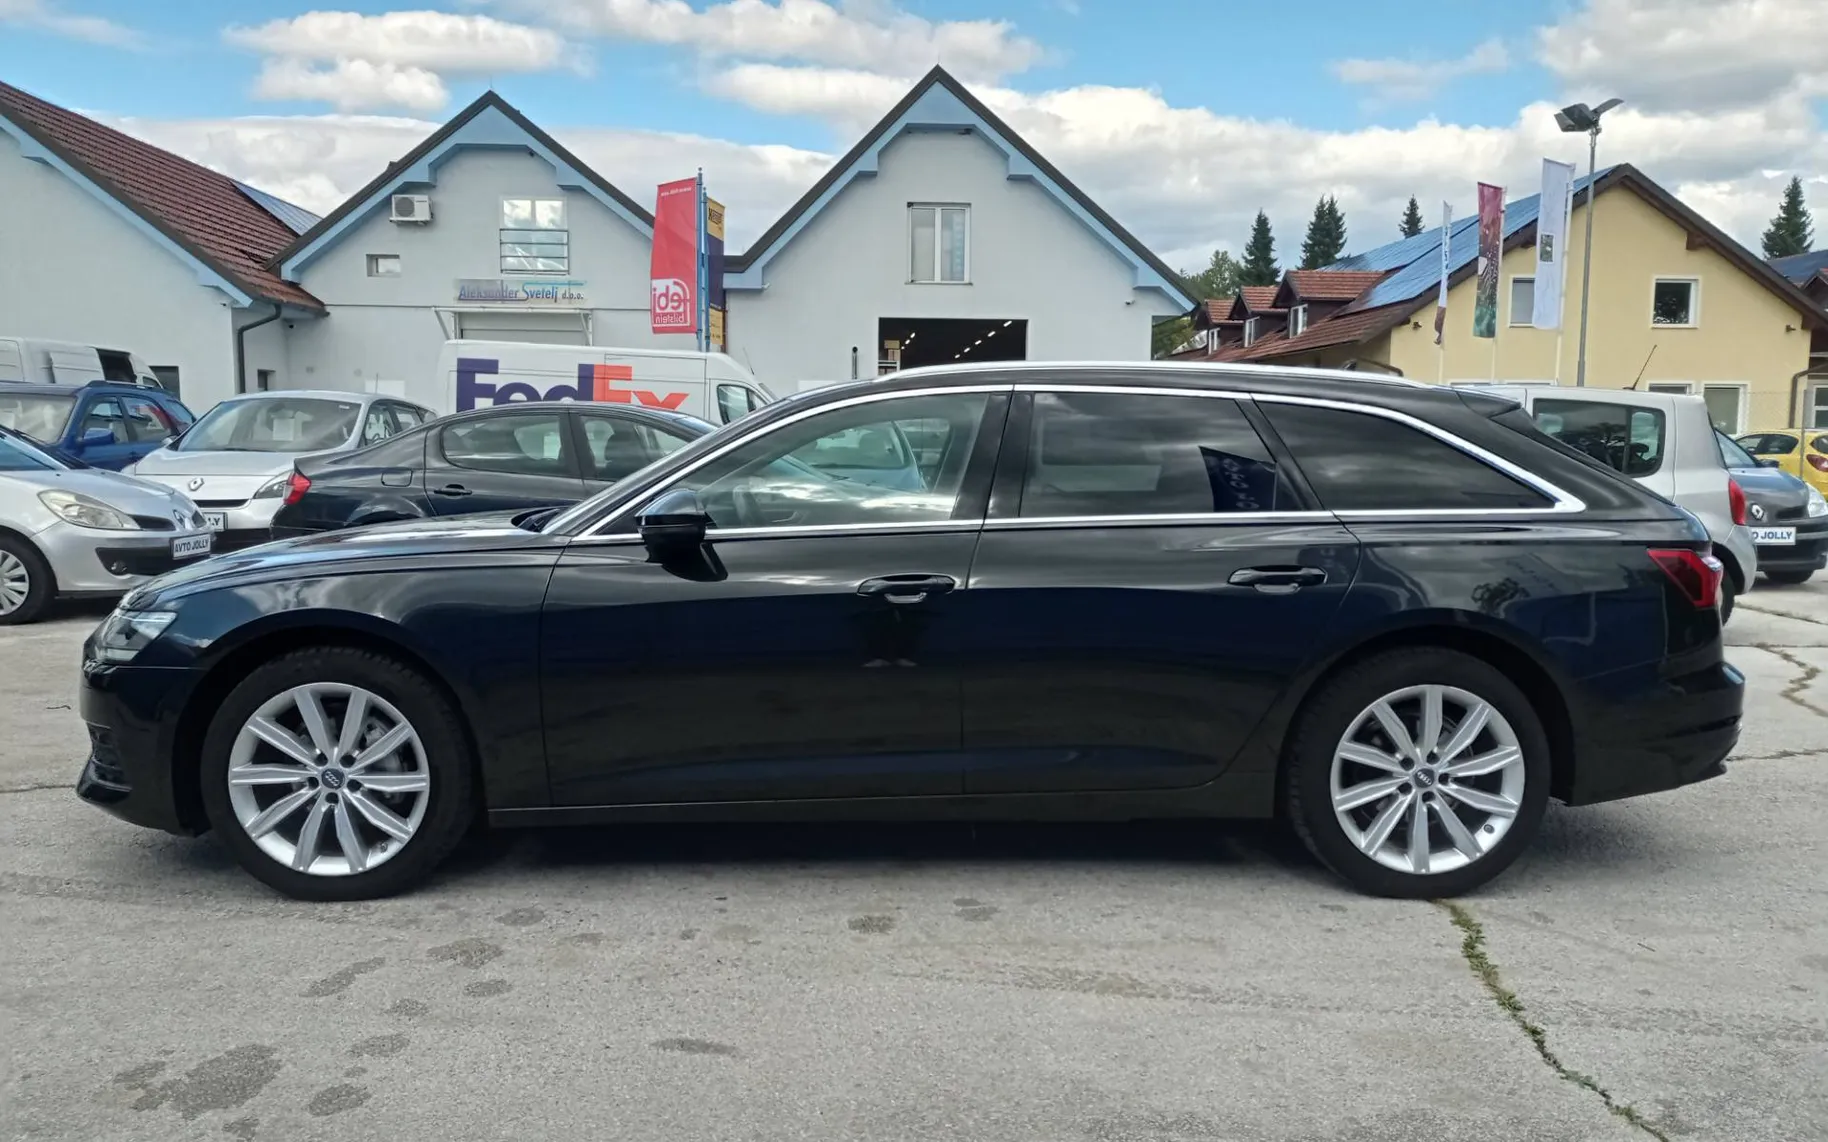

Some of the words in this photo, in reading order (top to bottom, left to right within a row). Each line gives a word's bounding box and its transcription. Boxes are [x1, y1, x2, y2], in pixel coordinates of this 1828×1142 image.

[458, 284, 519, 299] Aleksander
[522, 282, 559, 303] Svetelj
[1760, 531, 1793, 540] JOLLY
[174, 541, 191, 553] AVTO
[191, 538, 209, 550] JOLLY
